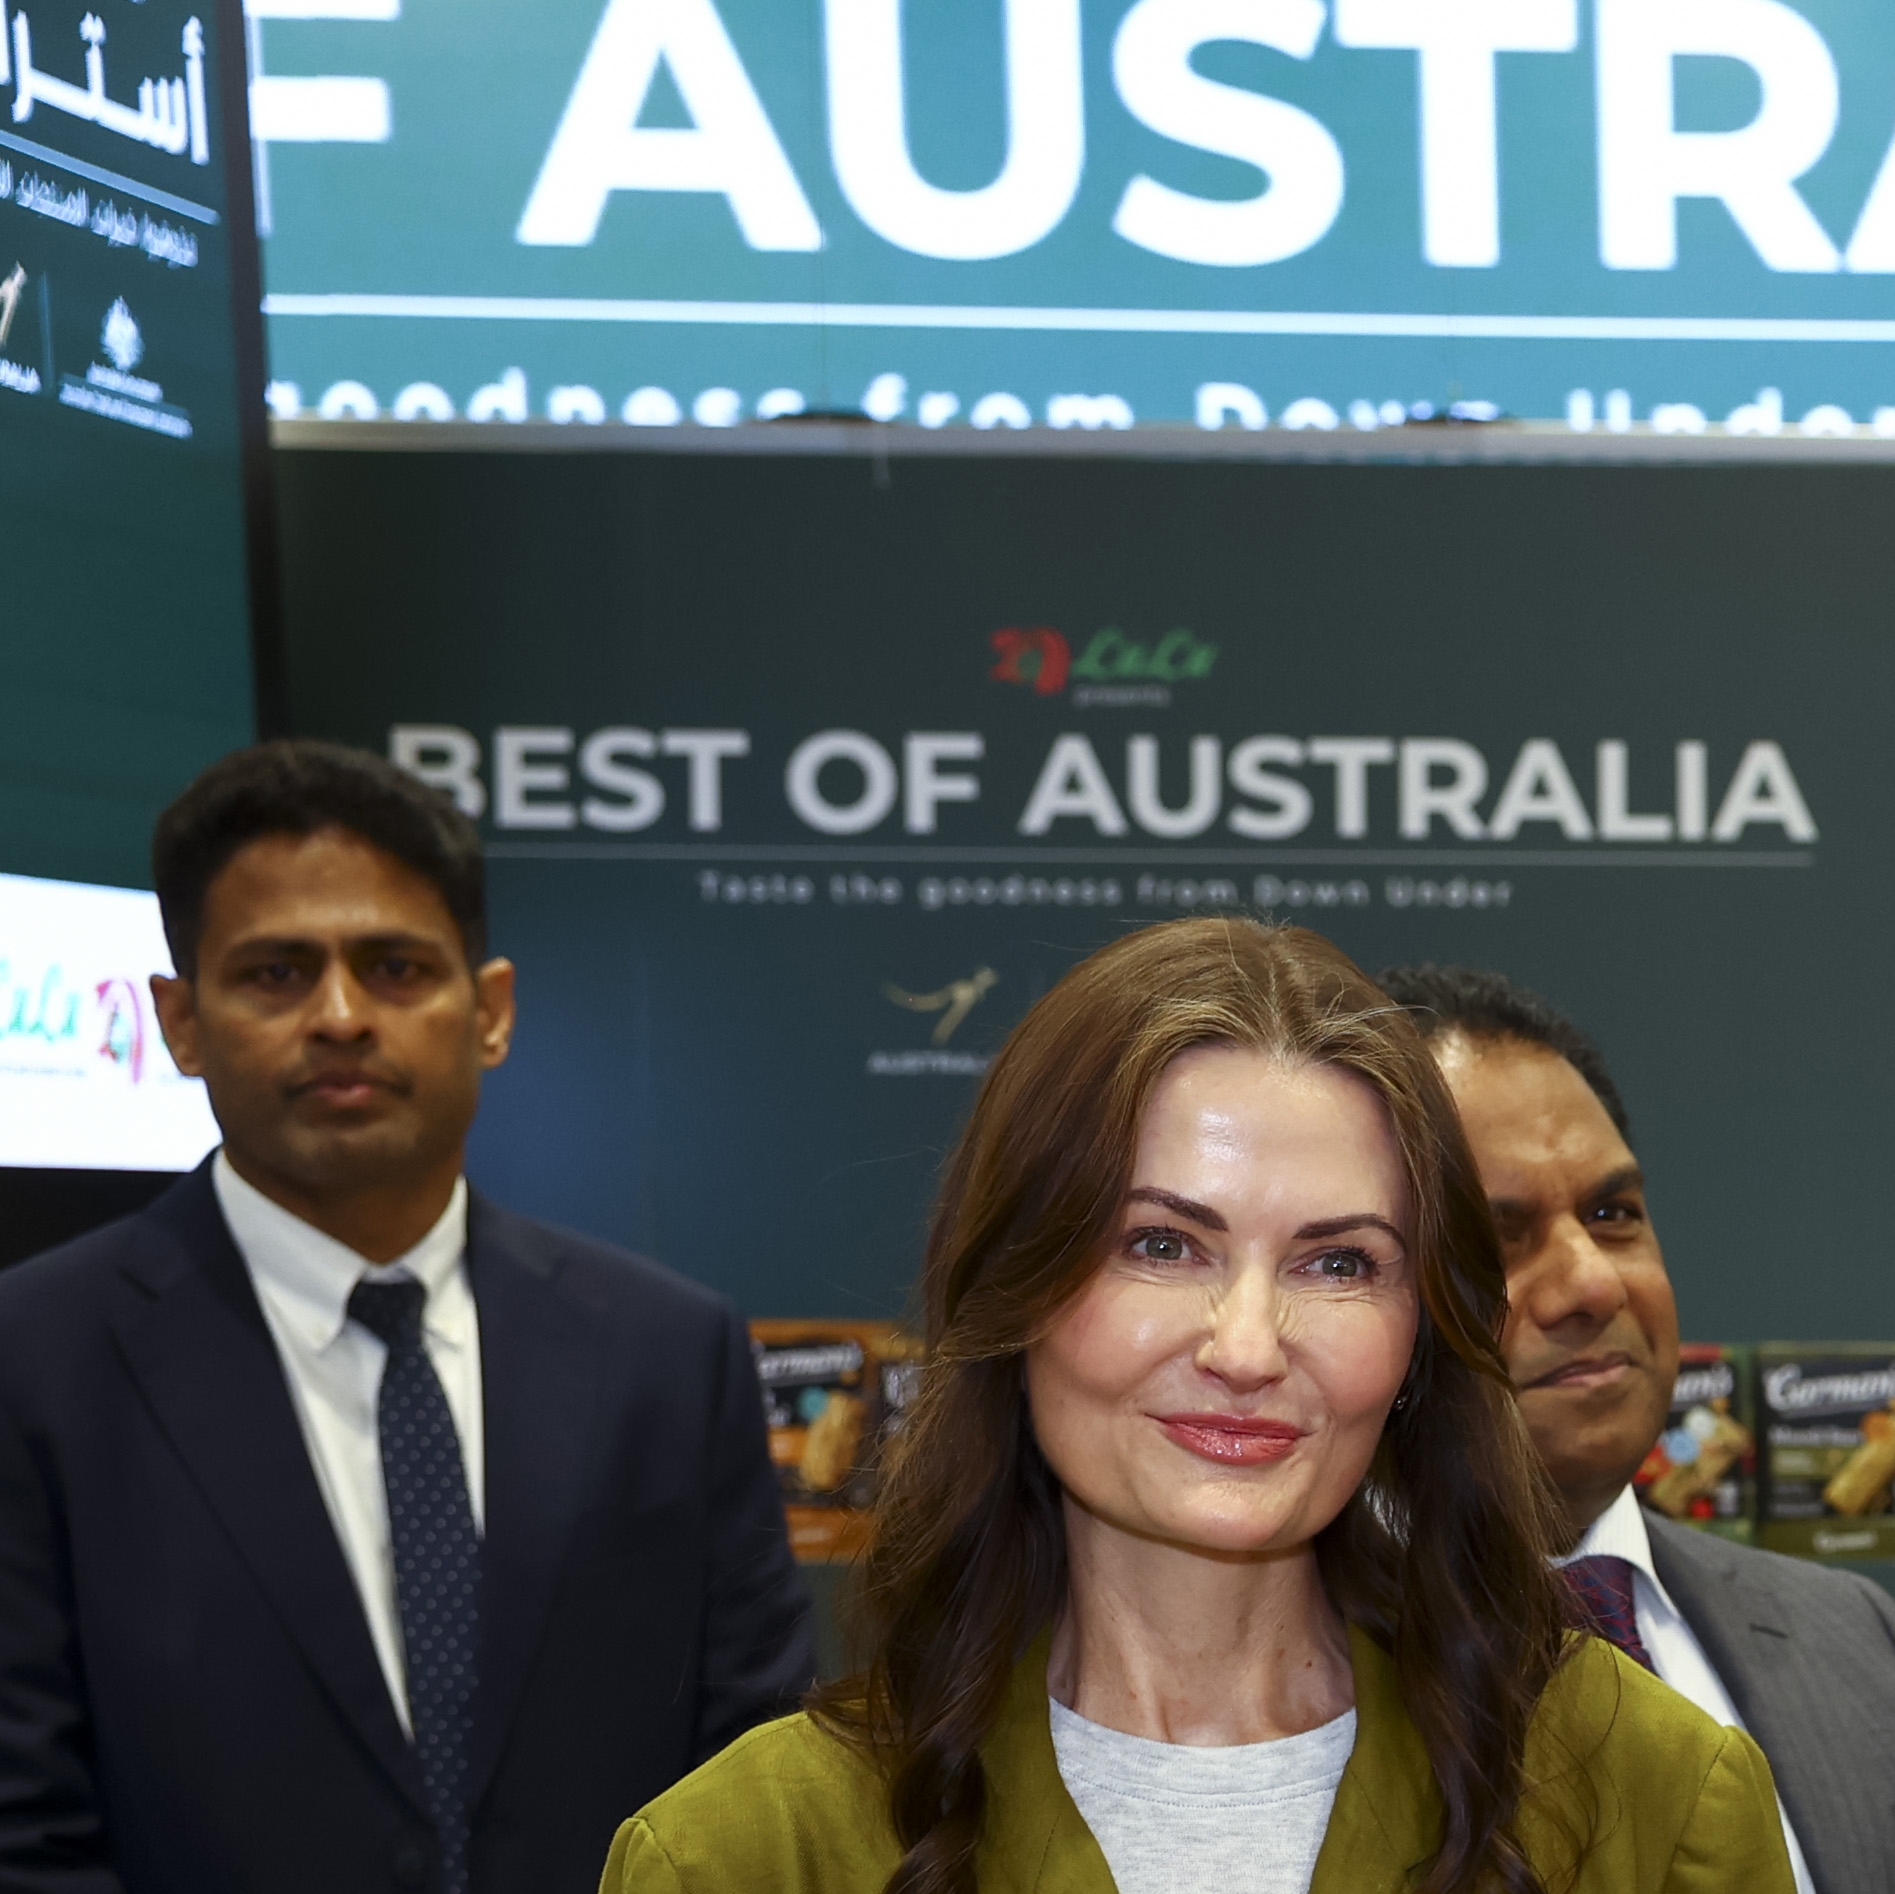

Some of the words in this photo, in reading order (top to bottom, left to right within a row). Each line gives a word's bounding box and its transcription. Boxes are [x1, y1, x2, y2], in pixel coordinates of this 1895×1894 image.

[784, 728, 986, 836] OF
[1016, 732, 1819, 843] AUSTRALIA
[698, 869, 815, 903] Taste
[829, 873, 902, 903] the
[917, 874, 1122, 910] goodness
[1136, 874, 1239, 905] from
[1253, 875, 1371, 906] Down
[1384, 876, 1513, 909] Under
